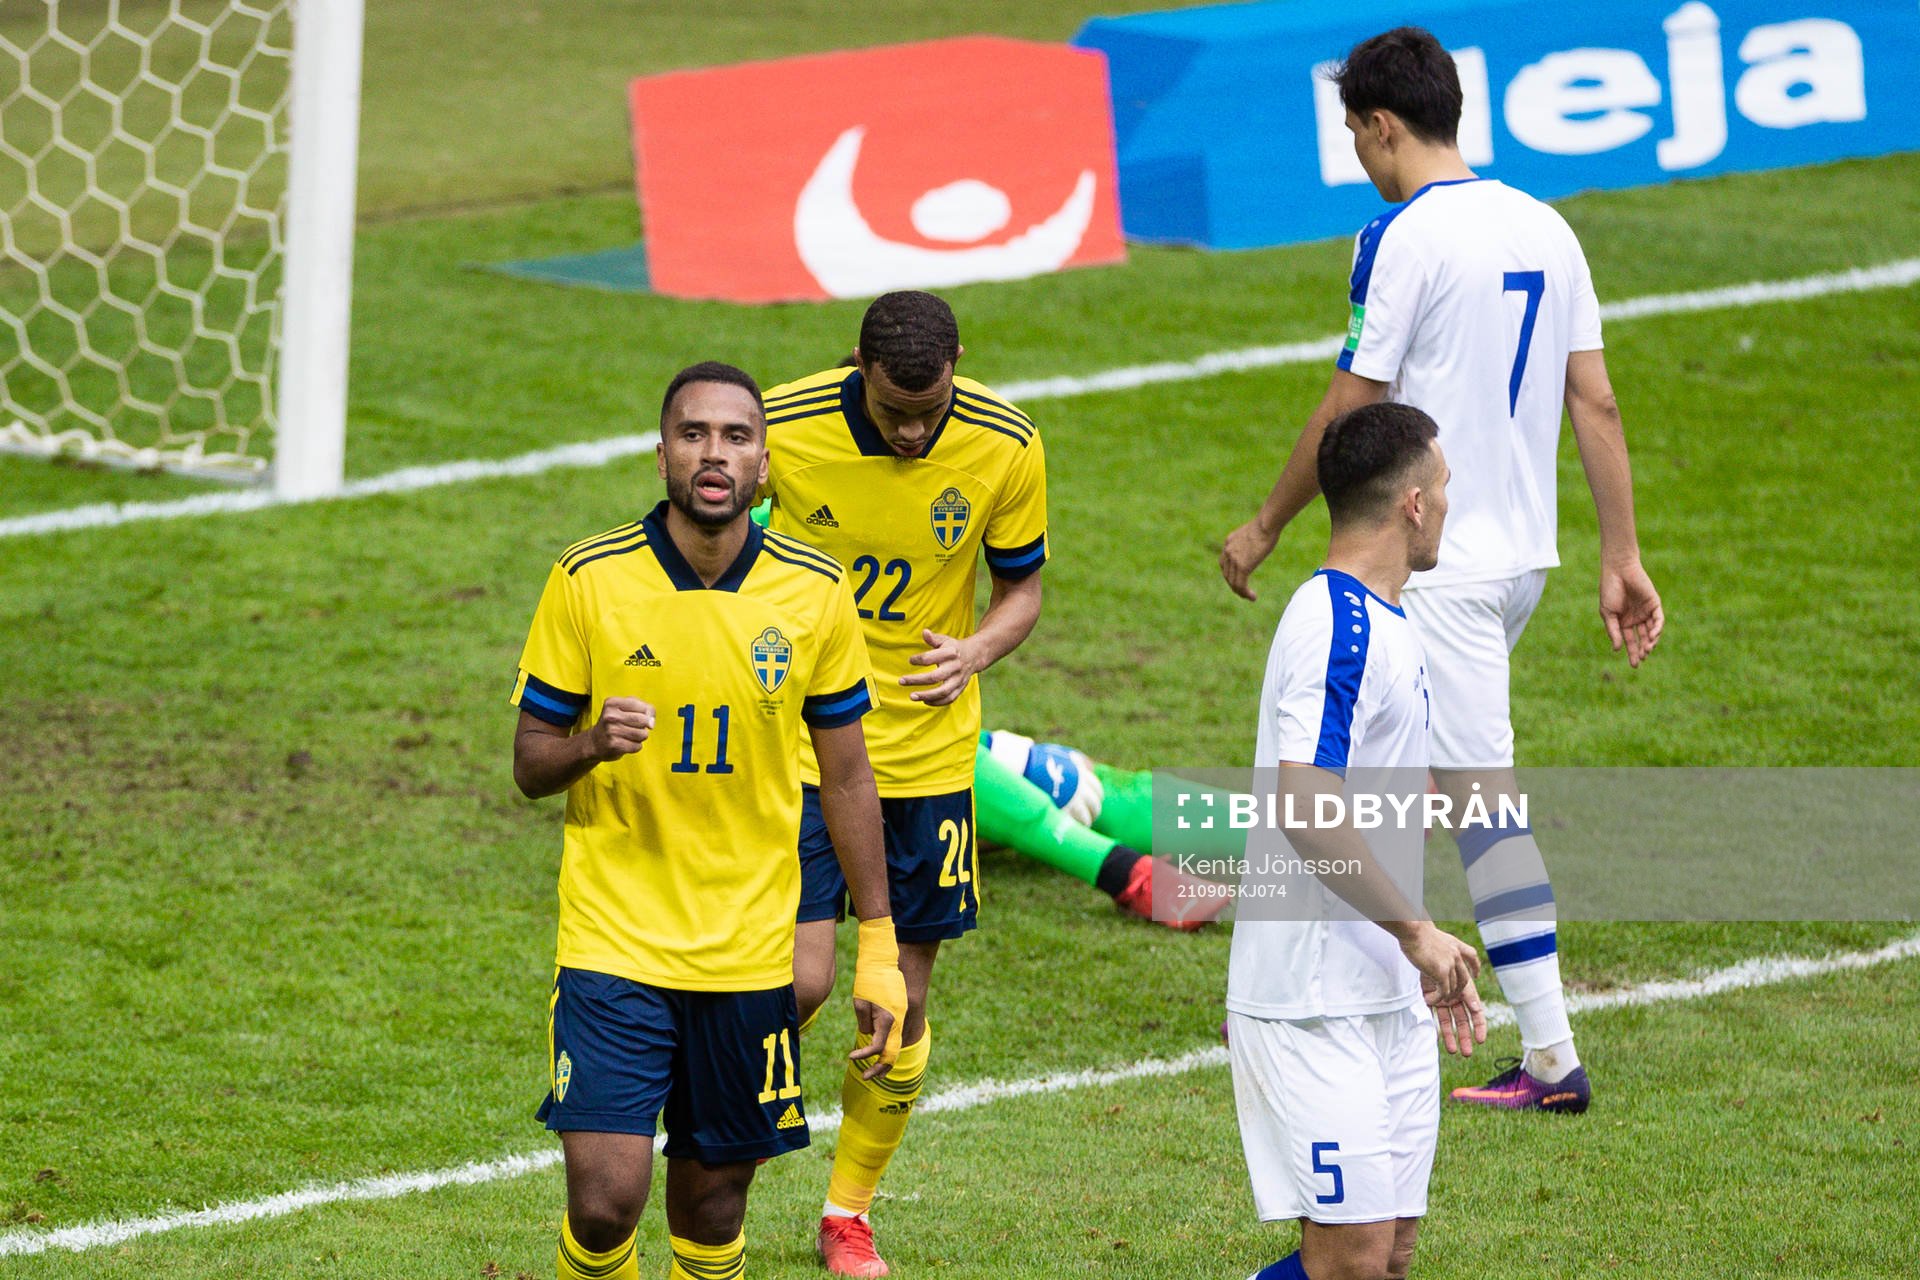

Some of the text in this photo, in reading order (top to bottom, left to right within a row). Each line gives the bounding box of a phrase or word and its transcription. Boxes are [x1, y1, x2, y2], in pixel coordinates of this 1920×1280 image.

[1503, 270, 1545, 418] 7
[806, 516, 839, 529] adidas
[853, 554, 912, 621] 22
[623, 658, 662, 667] adidas
[671, 704, 734, 774] 11
[758, 1028, 801, 1104] 11
[777, 1117, 806, 1129] adidas
[1311, 1141, 1345, 1204] 5
